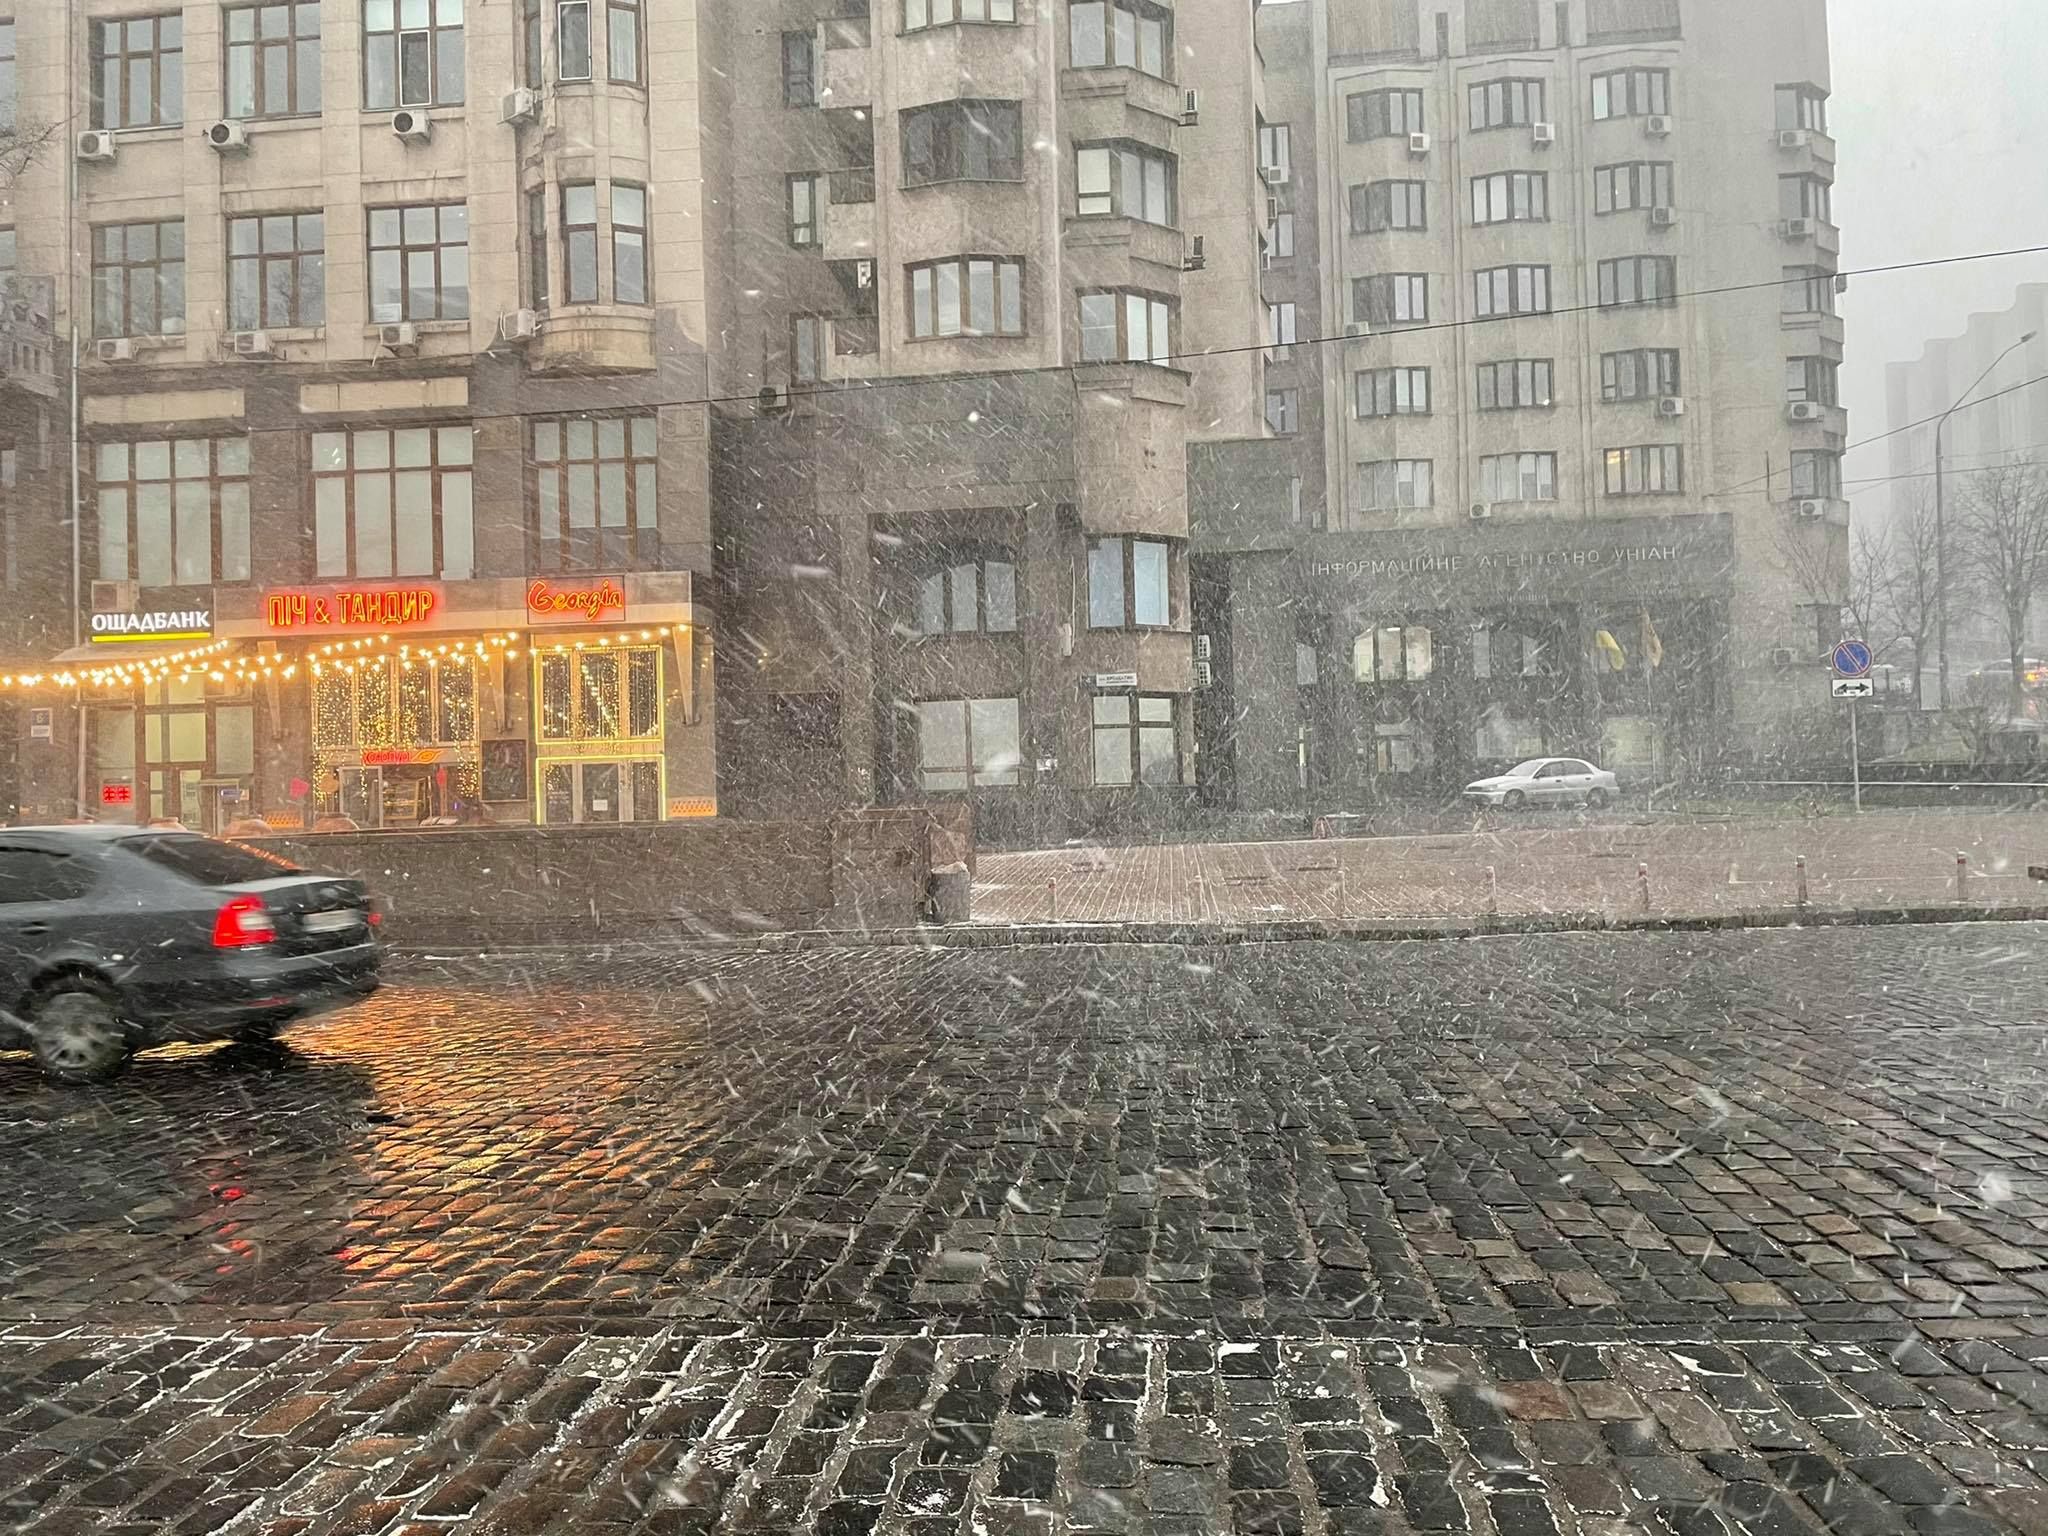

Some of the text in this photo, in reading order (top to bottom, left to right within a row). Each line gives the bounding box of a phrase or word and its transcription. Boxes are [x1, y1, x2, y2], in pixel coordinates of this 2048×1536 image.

[1614, 546, 1676, 561] УНІАН
[269, 591, 433, 626] ПІЧ & ТАНДИР
[528, 580, 623, 620] Georgia
[91, 610, 211, 633] ОЩАДБАНК
